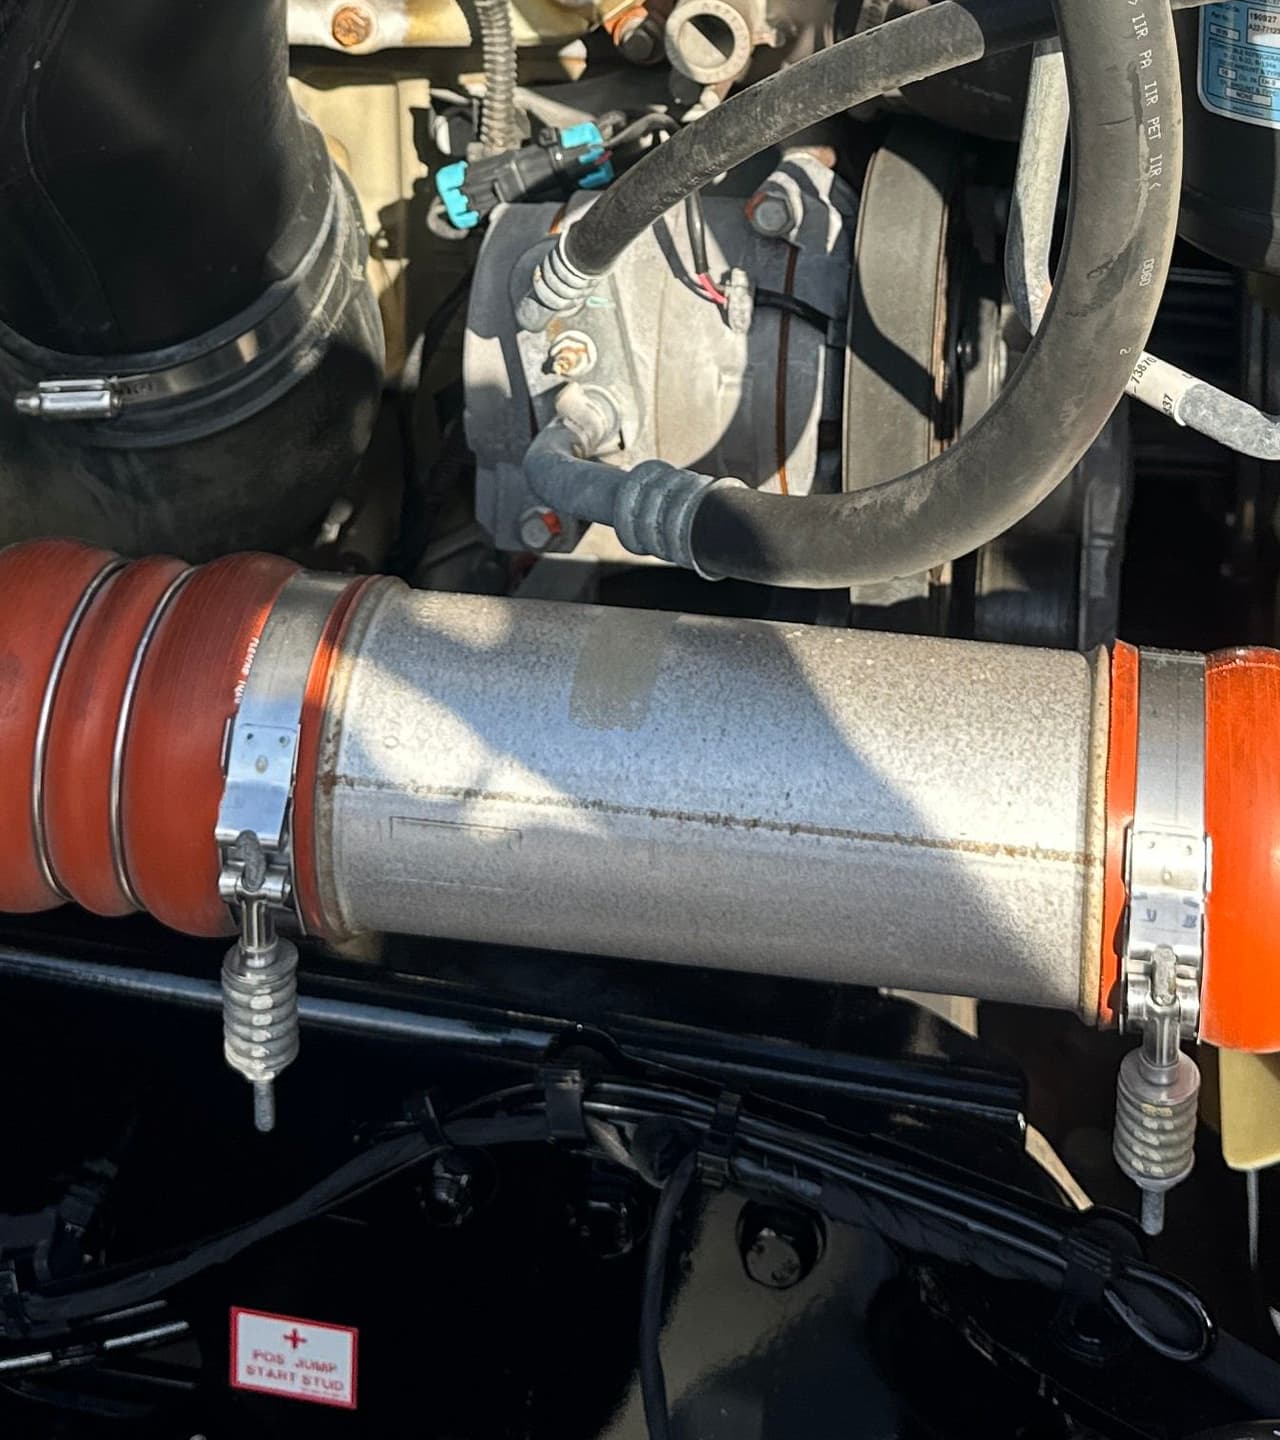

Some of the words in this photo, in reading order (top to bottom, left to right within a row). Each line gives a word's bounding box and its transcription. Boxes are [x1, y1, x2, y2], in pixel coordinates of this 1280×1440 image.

[1138, 50, 1154, 70] PA
[1146, 116, 1163, 141] PET
[252, 1349, 286, 1365] POS
[294, 1357, 338, 1374] JUMP
[245, 1364, 297, 1384] START
[301, 1374, 345, 1392] STUD
